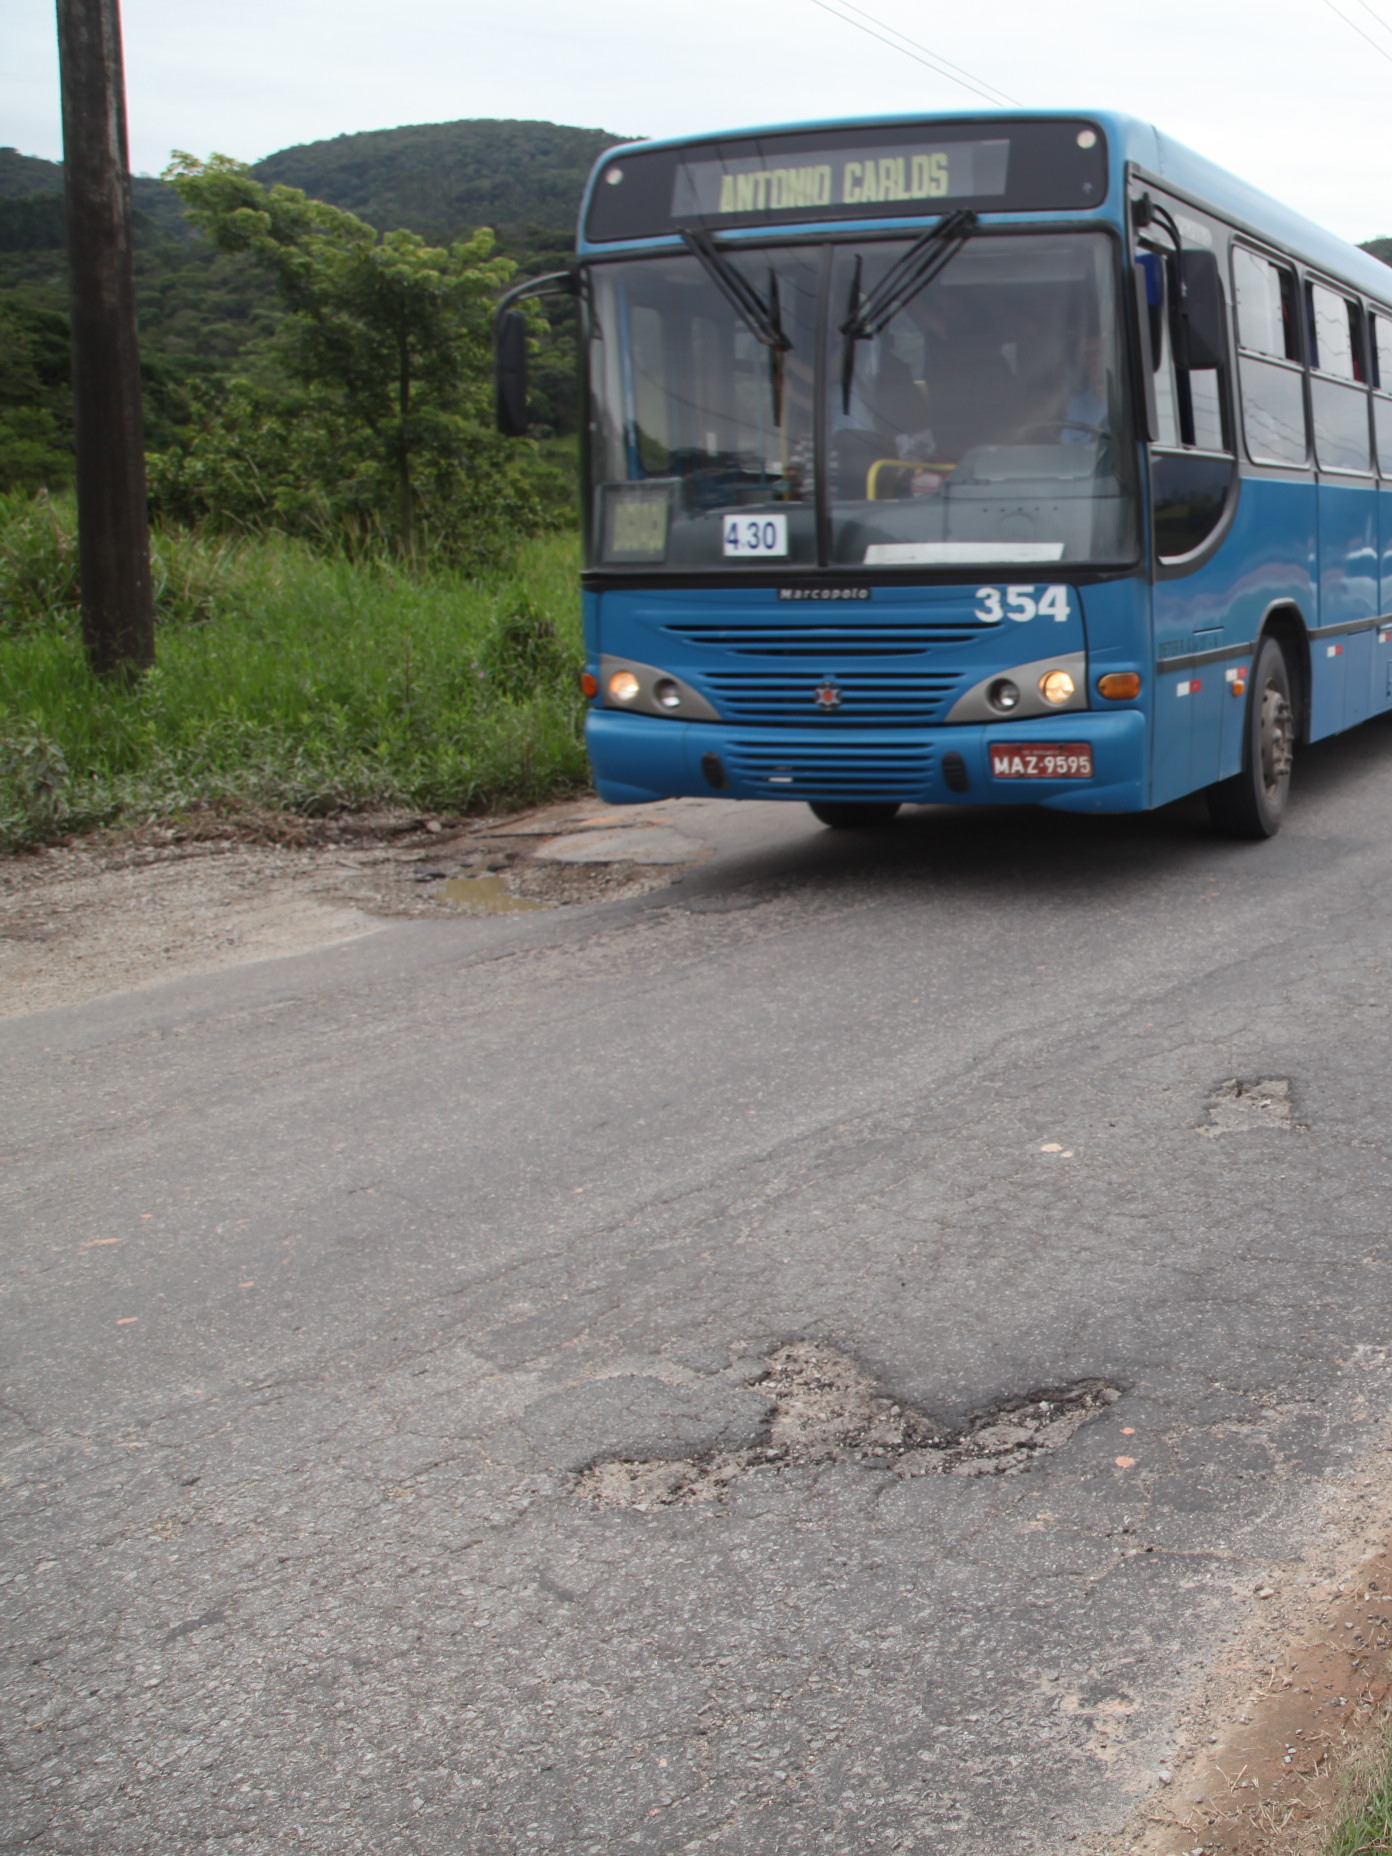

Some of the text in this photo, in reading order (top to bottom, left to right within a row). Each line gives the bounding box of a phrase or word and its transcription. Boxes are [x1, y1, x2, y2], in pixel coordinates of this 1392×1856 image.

[718, 153, 948, 213] ANTONIO CARLOS
[974, 585, 1071, 623] 354
